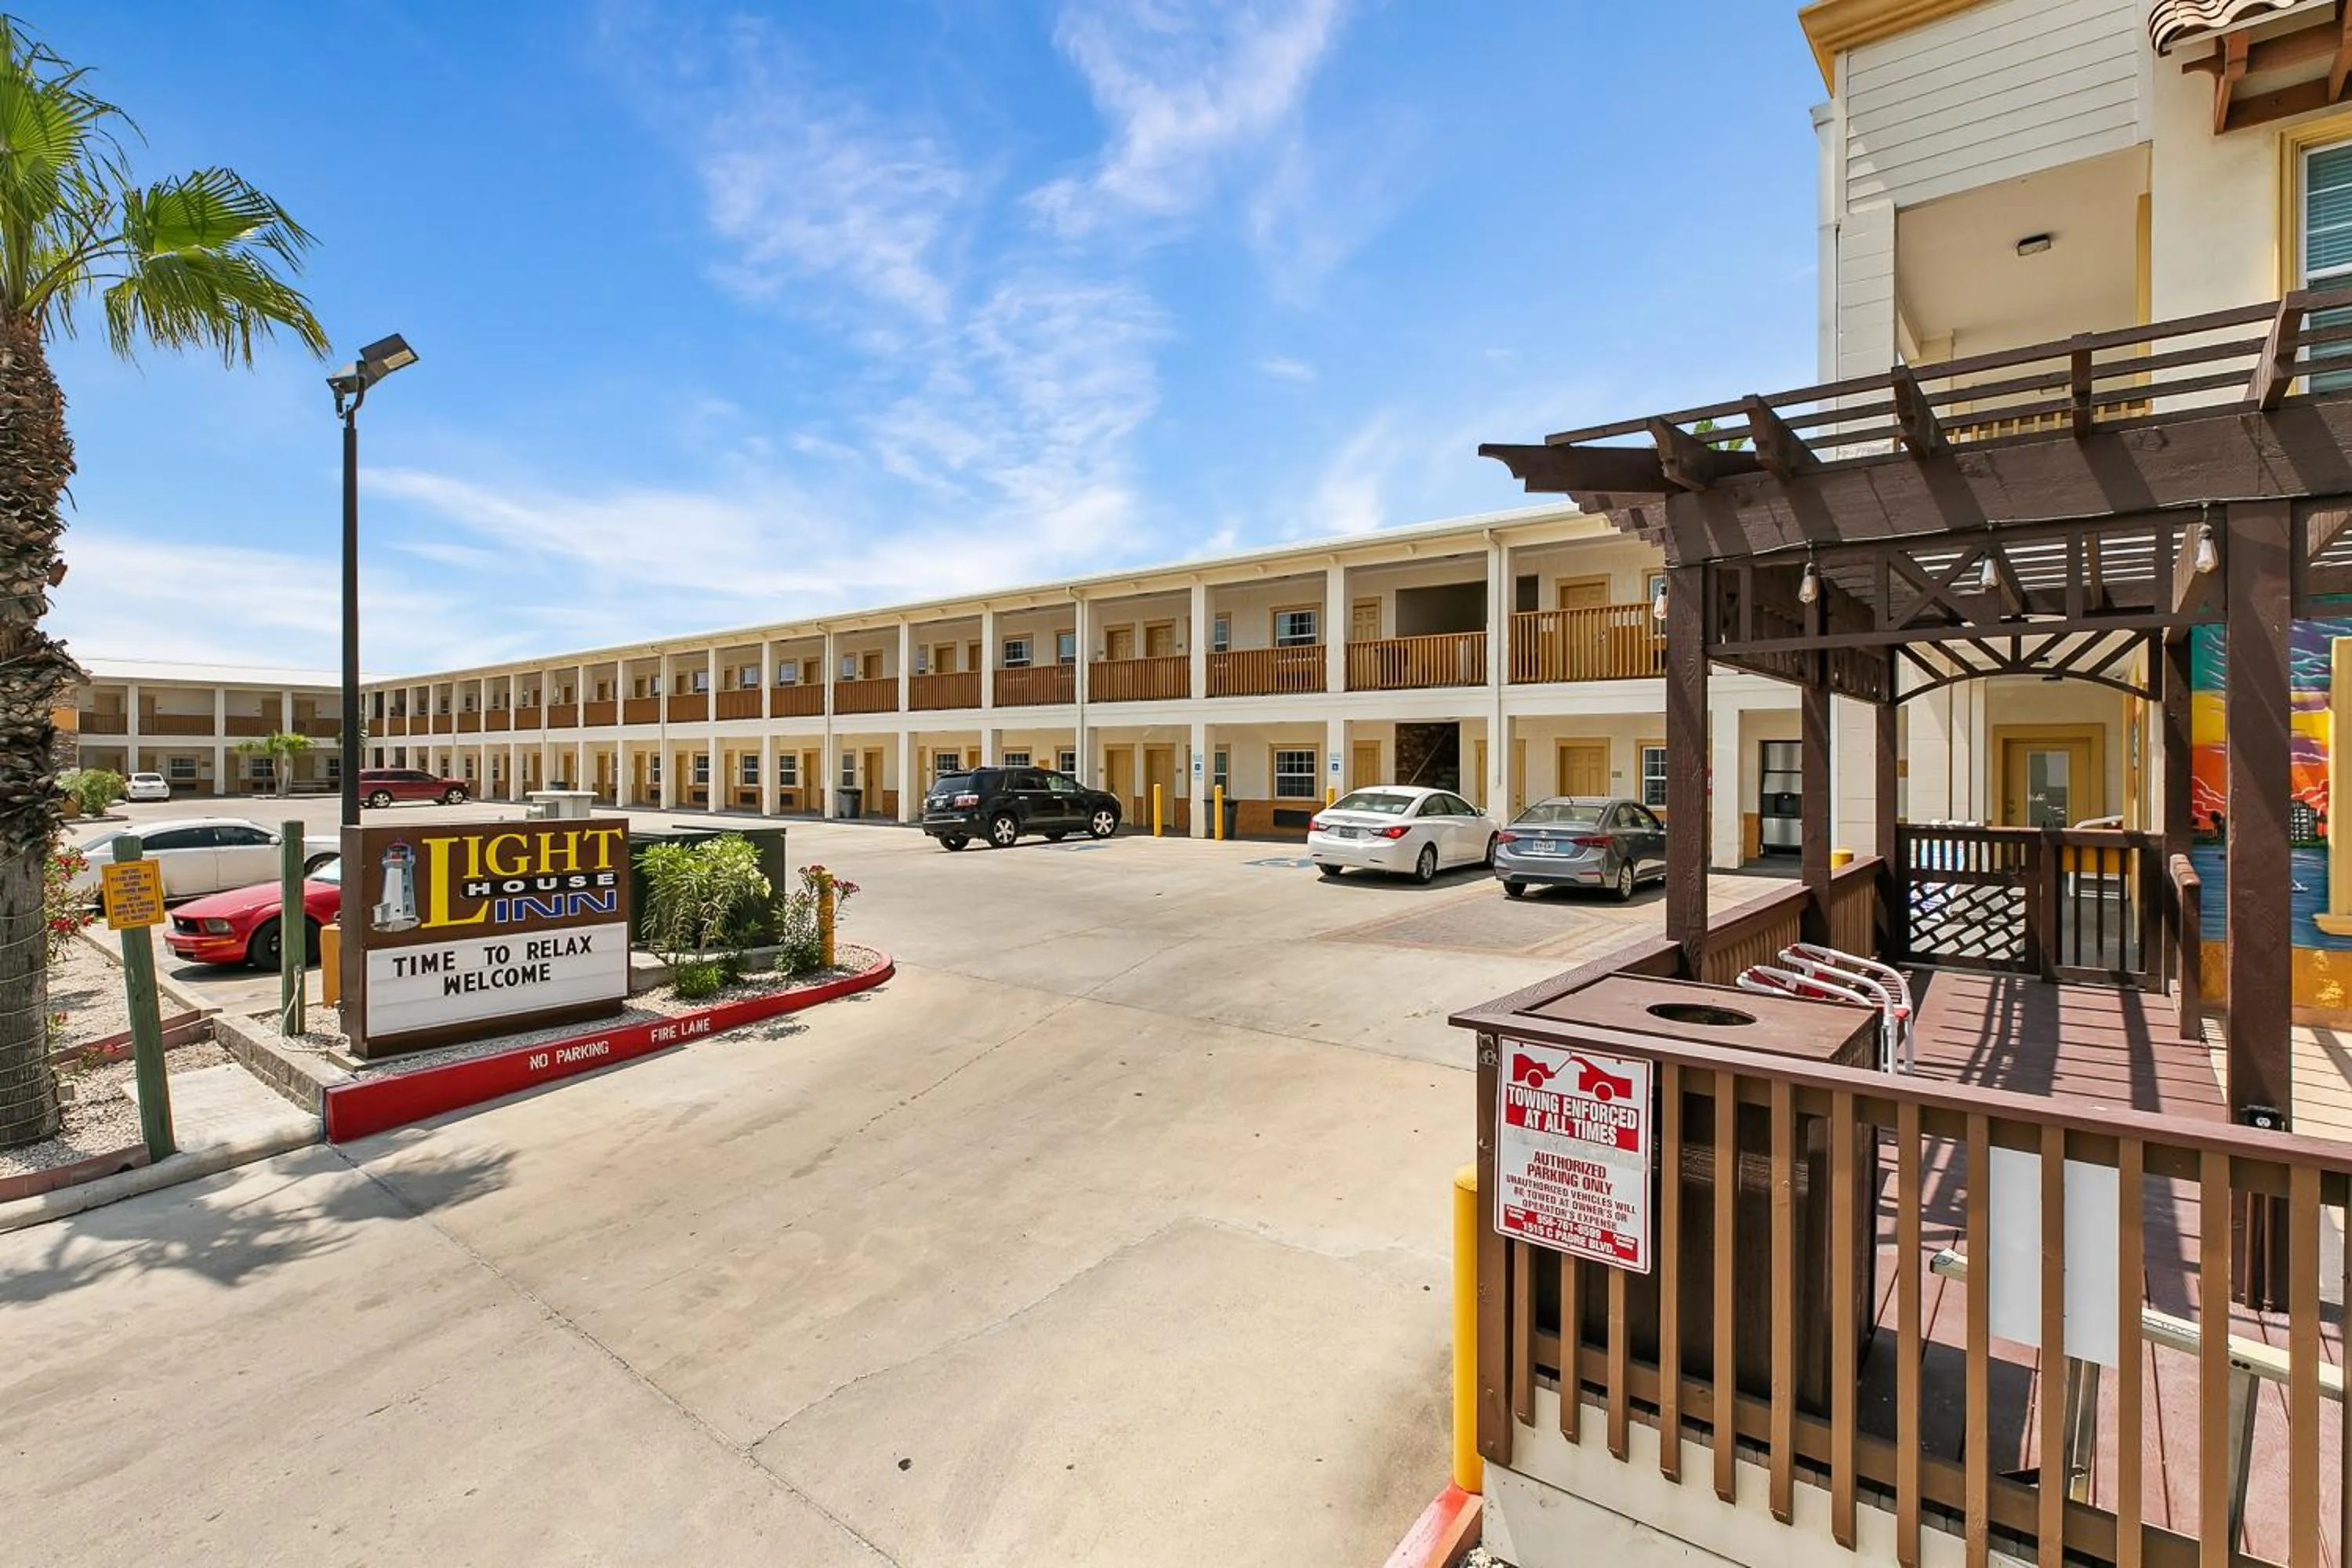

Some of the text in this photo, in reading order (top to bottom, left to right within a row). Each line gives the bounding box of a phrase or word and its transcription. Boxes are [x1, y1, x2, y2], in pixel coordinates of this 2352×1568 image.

[421, 827, 624, 929] LIGHT
[468, 873, 615, 896] HOUSE
[494, 889, 617, 923] INN
[394, 935, 592, 977] TIME TO RELAX
[443, 964, 551, 996] WELCOME
[529, 1018, 710, 1070] NO PARKING FIRE LANE
[1508, 1086, 1638, 1129] TOWING ENFORCED
[1524, 1109, 1617, 1145] AT ALL TIMES
[1527, 1163, 1613, 1195] PARKING ONLY
[1534, 1151, 1606, 1178] AUTHORIZED
[1507, 1174, 1636, 1214] UNAUTHORIZED VEHICLES WILL
[1514, 1187, 1628, 1222] BE TOWED AT OWNER'S OR
[1523, 1200, 1574, 1220] OPERATOR'S
[1577, 1214, 1617, 1231] EXPENSE
[1555, 1229, 1587, 1247] PADRE
[1588, 1239, 1617, 1255] BLVD.
